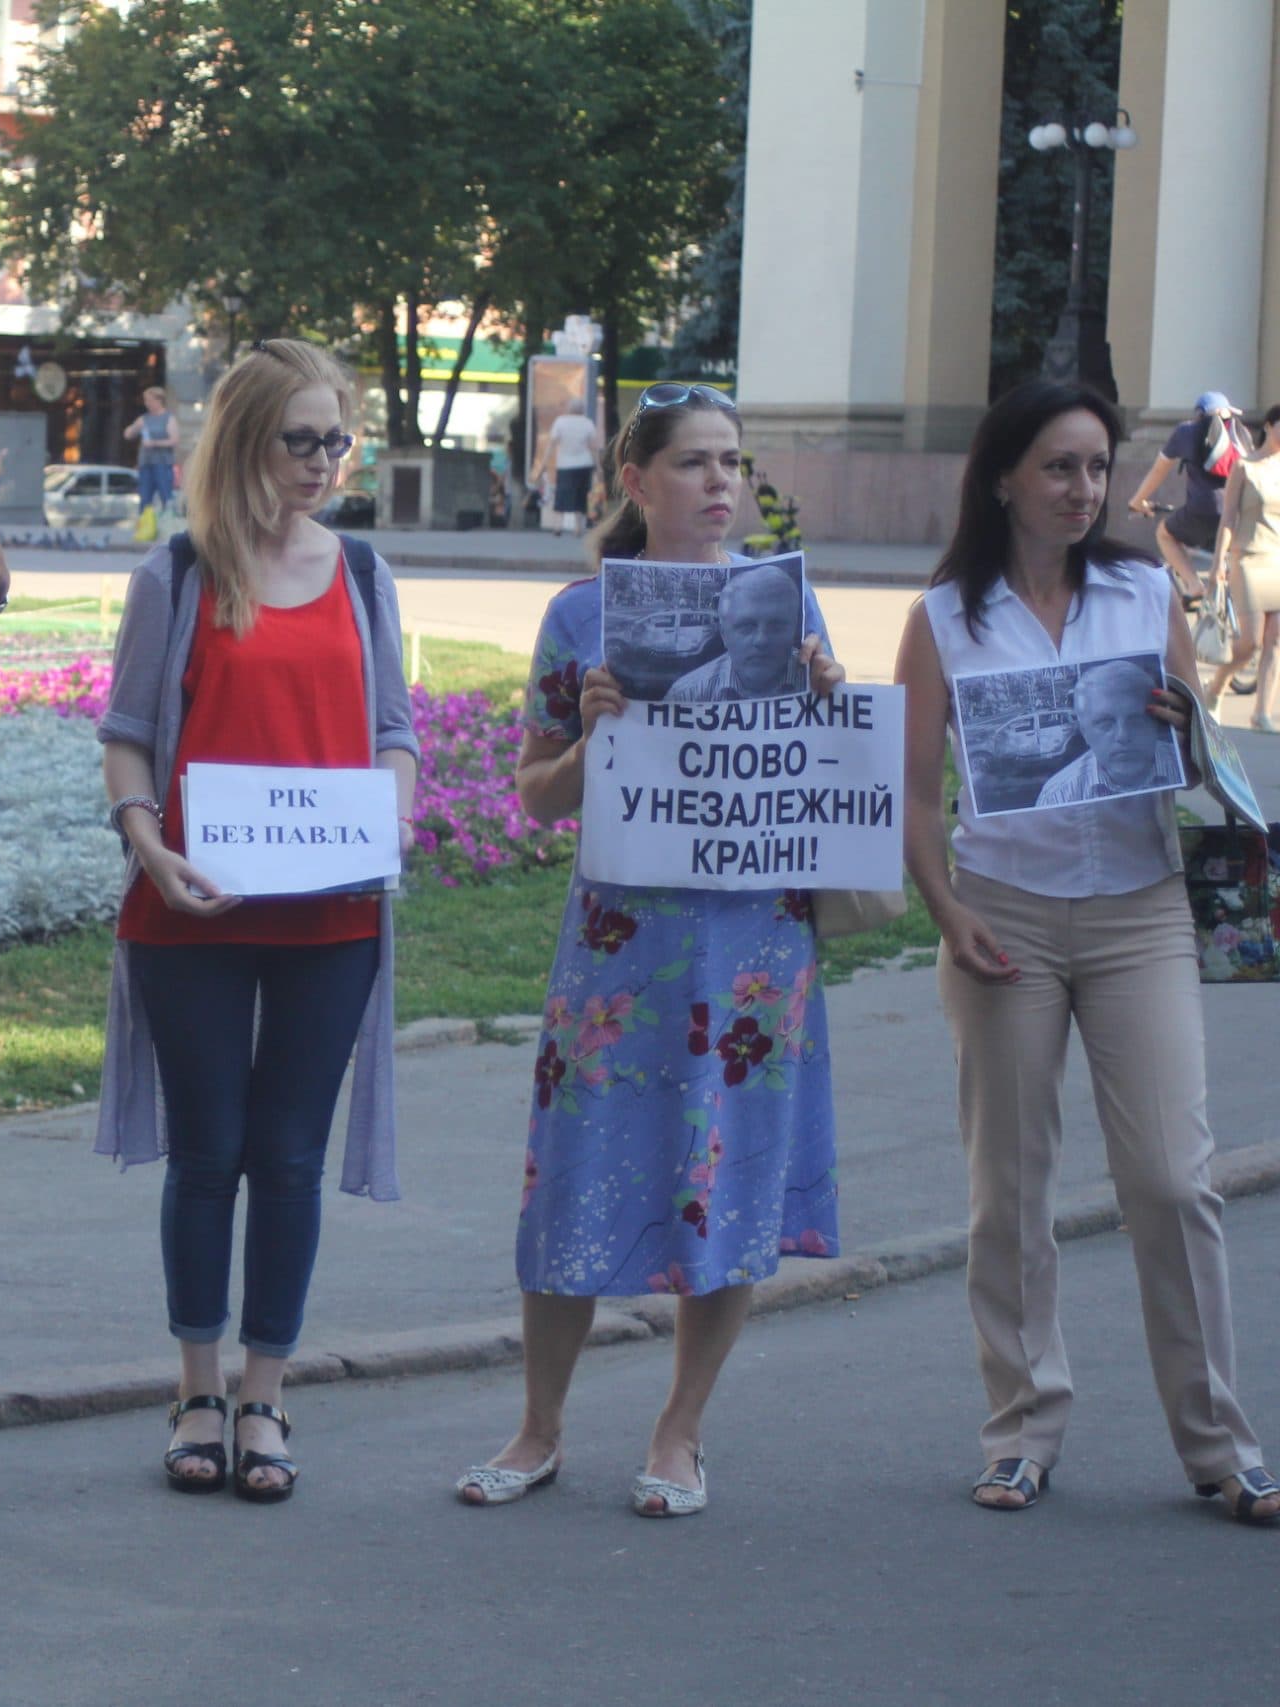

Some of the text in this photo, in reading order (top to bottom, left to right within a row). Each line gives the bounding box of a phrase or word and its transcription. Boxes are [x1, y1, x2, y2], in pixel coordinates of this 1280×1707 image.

[647, 693, 873, 730] НЕЗАЛЕЖНЕ
[679, 741, 807, 780] СЛОВО
[268, 789, 317, 808] РІК
[621, 784, 893, 828] У НЕЗАЛЕЖНІЙ
[201, 824, 370, 844] БЕЗ ПАВЛА
[691, 831, 818, 875] КРАЇНІ!
